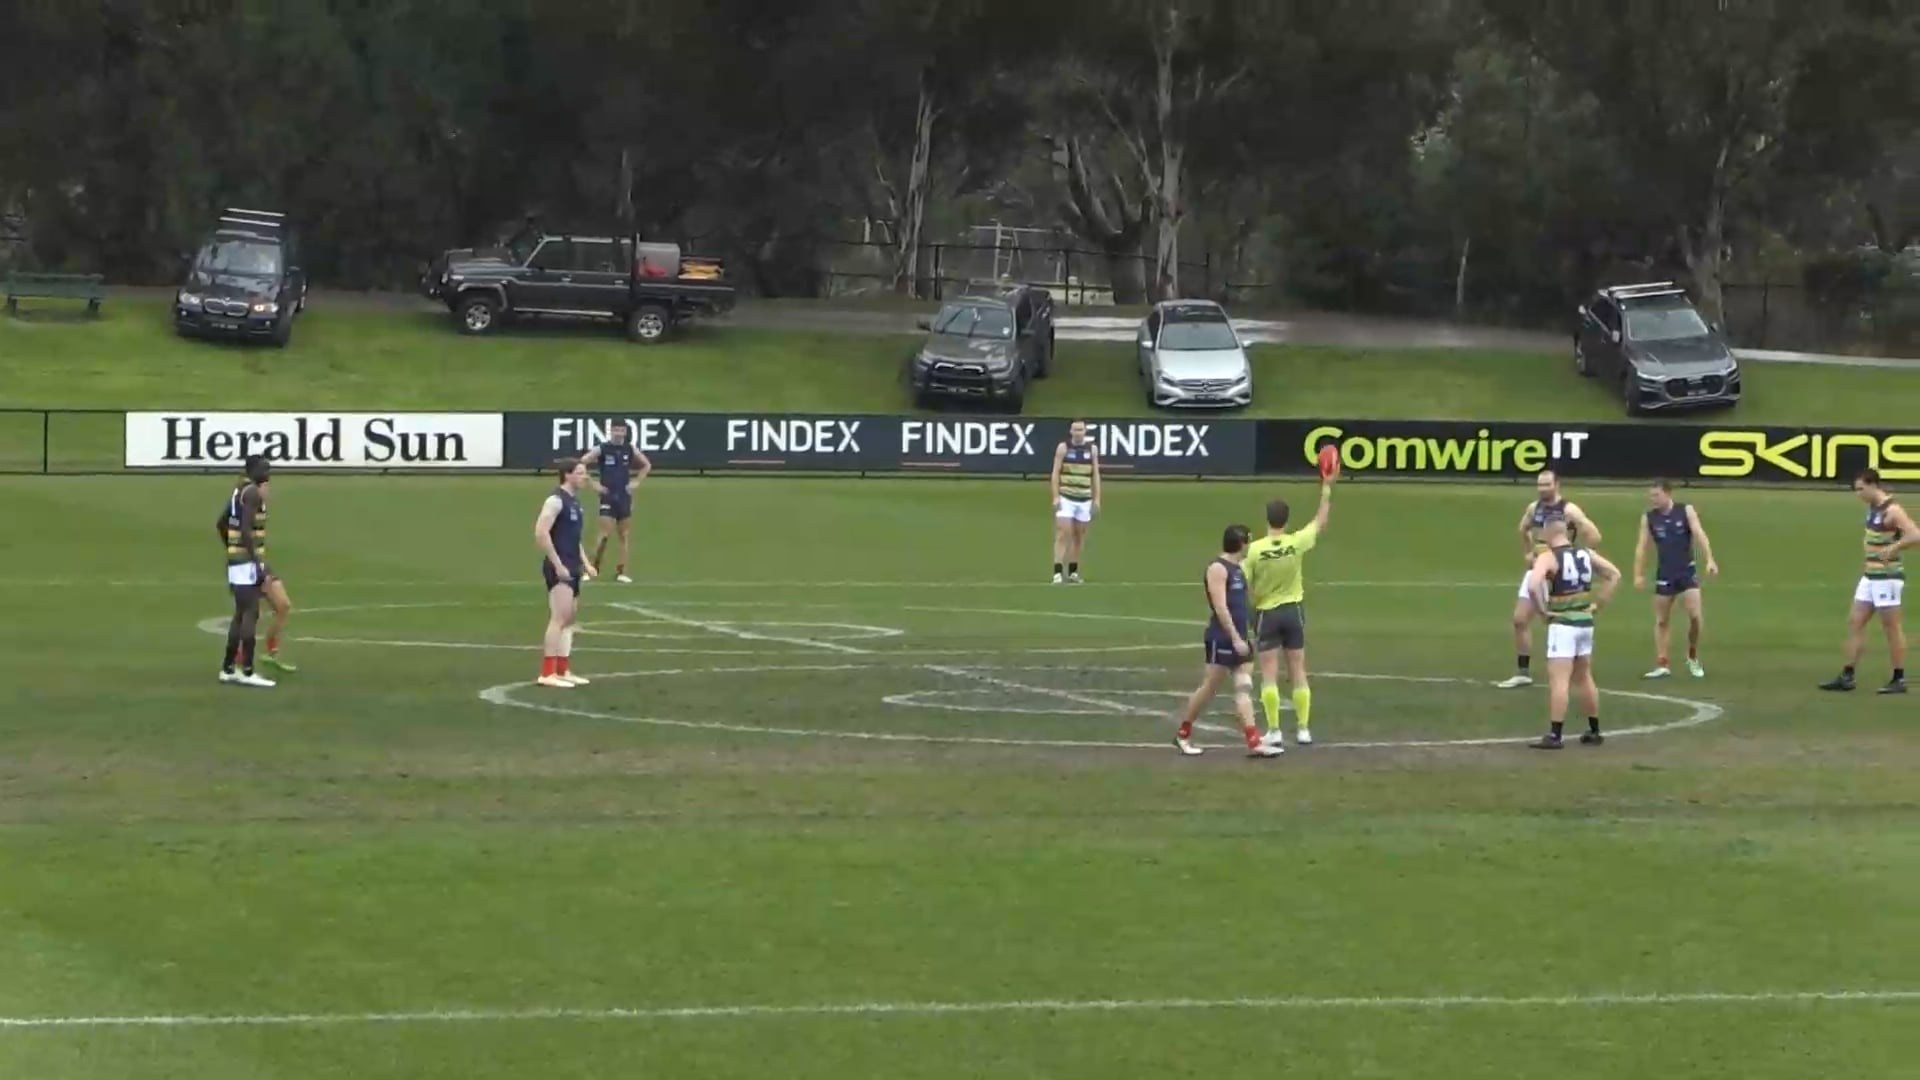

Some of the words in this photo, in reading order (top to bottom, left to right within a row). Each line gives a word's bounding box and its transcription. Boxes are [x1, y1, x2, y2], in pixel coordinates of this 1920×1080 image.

[162, 417, 342, 462] Herald
[363, 418, 467, 462] Sun
[727, 420, 860, 453] FINDEX
[901, 421, 1034, 455] FINDEX
[1562, 549, 1592, 586] 43
